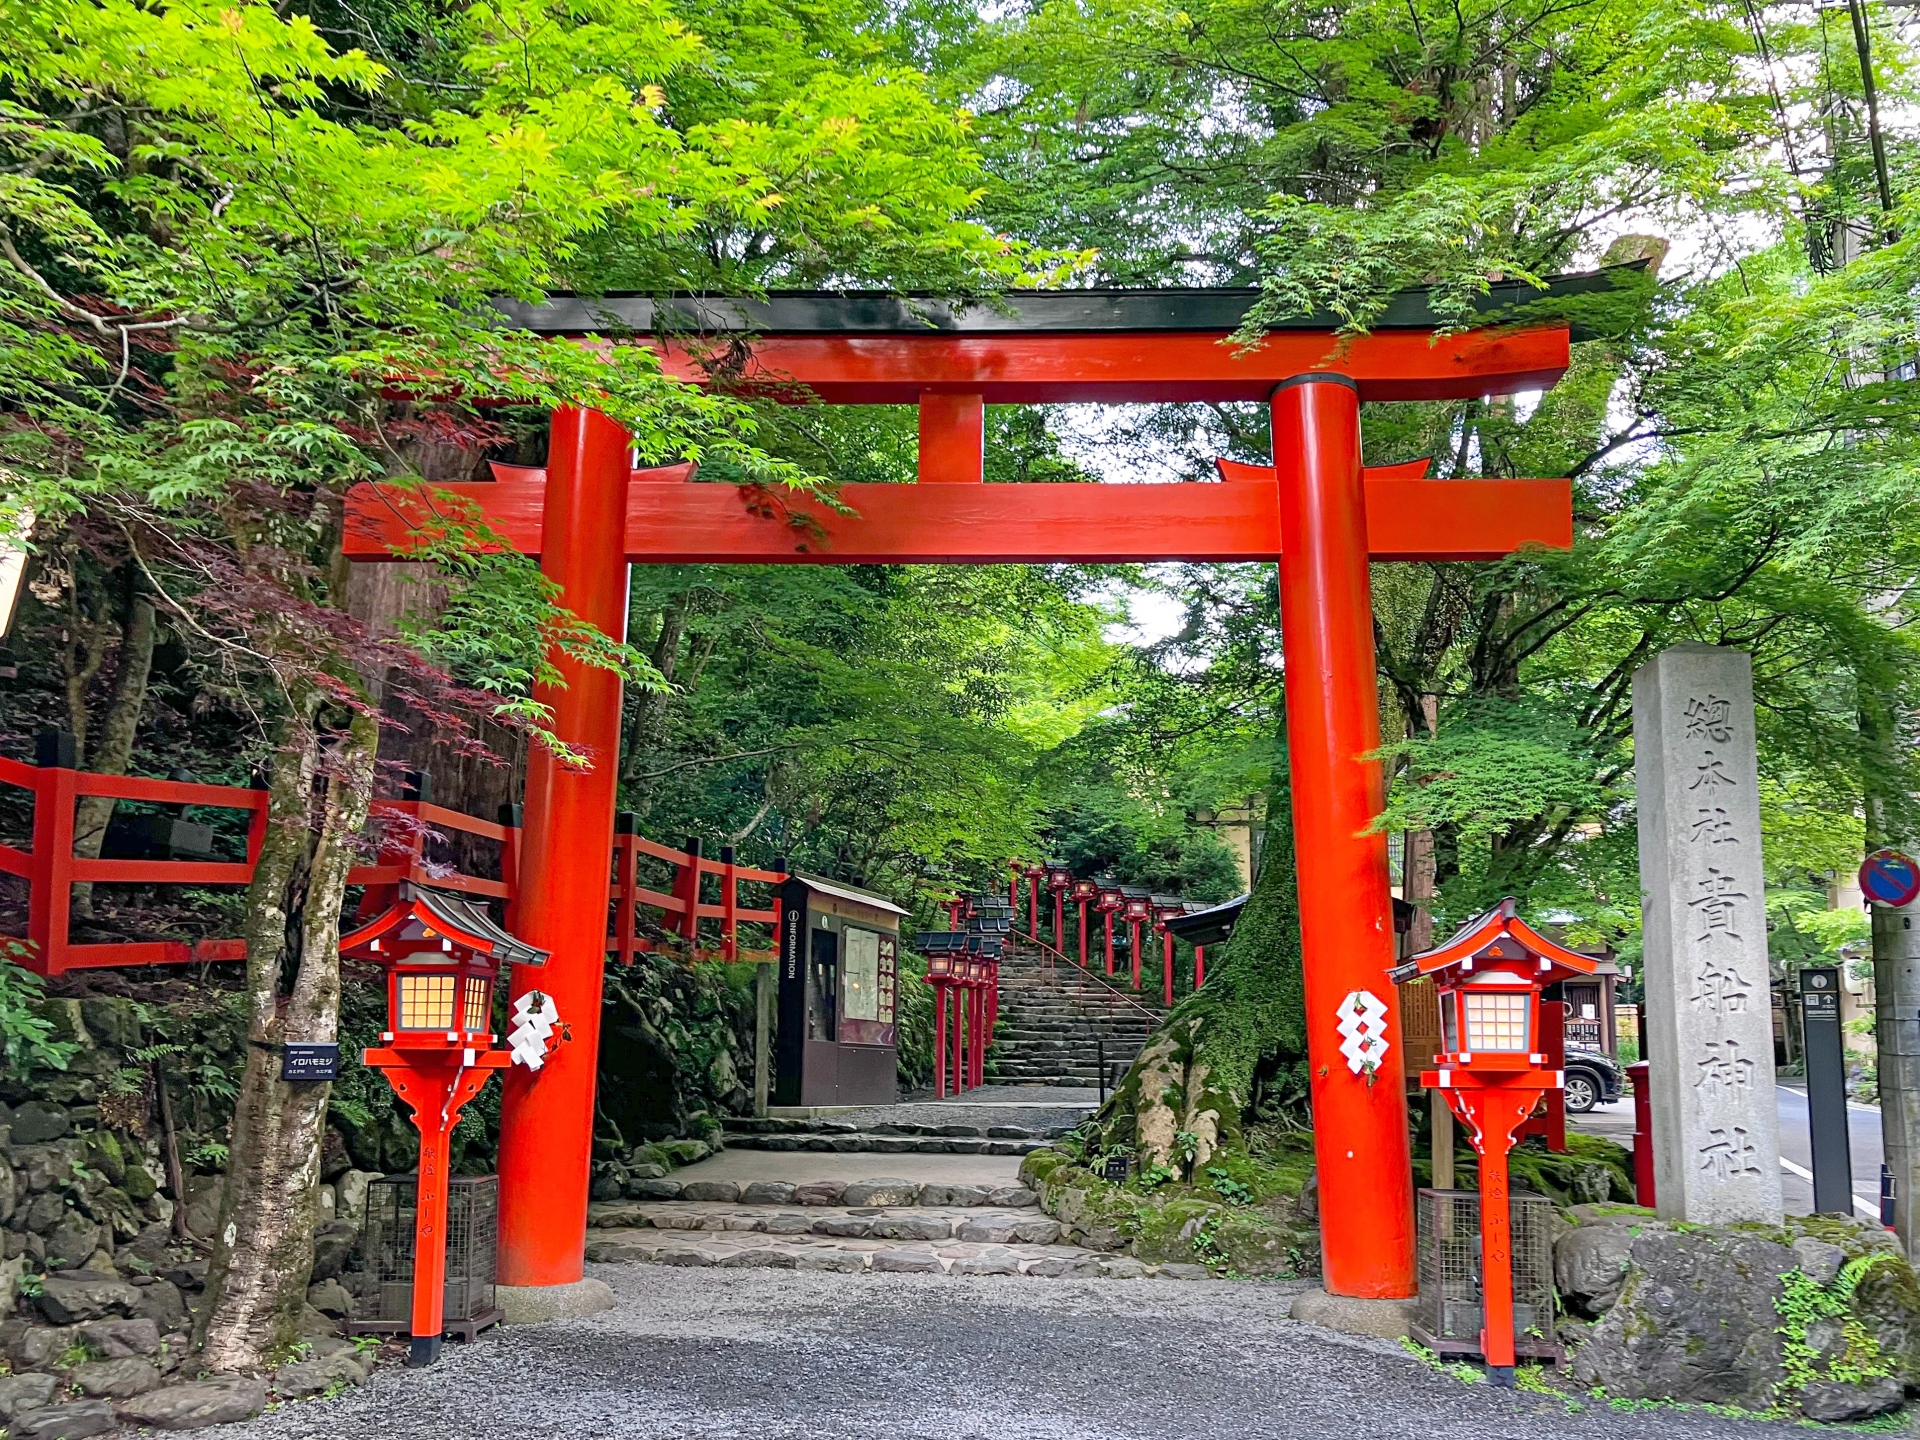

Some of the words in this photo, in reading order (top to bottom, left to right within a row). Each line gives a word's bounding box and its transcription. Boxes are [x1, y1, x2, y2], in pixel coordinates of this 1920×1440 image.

[788, 922, 797, 979] INFORMATION
[291, 1058, 333, 1066] イロハモミジ
